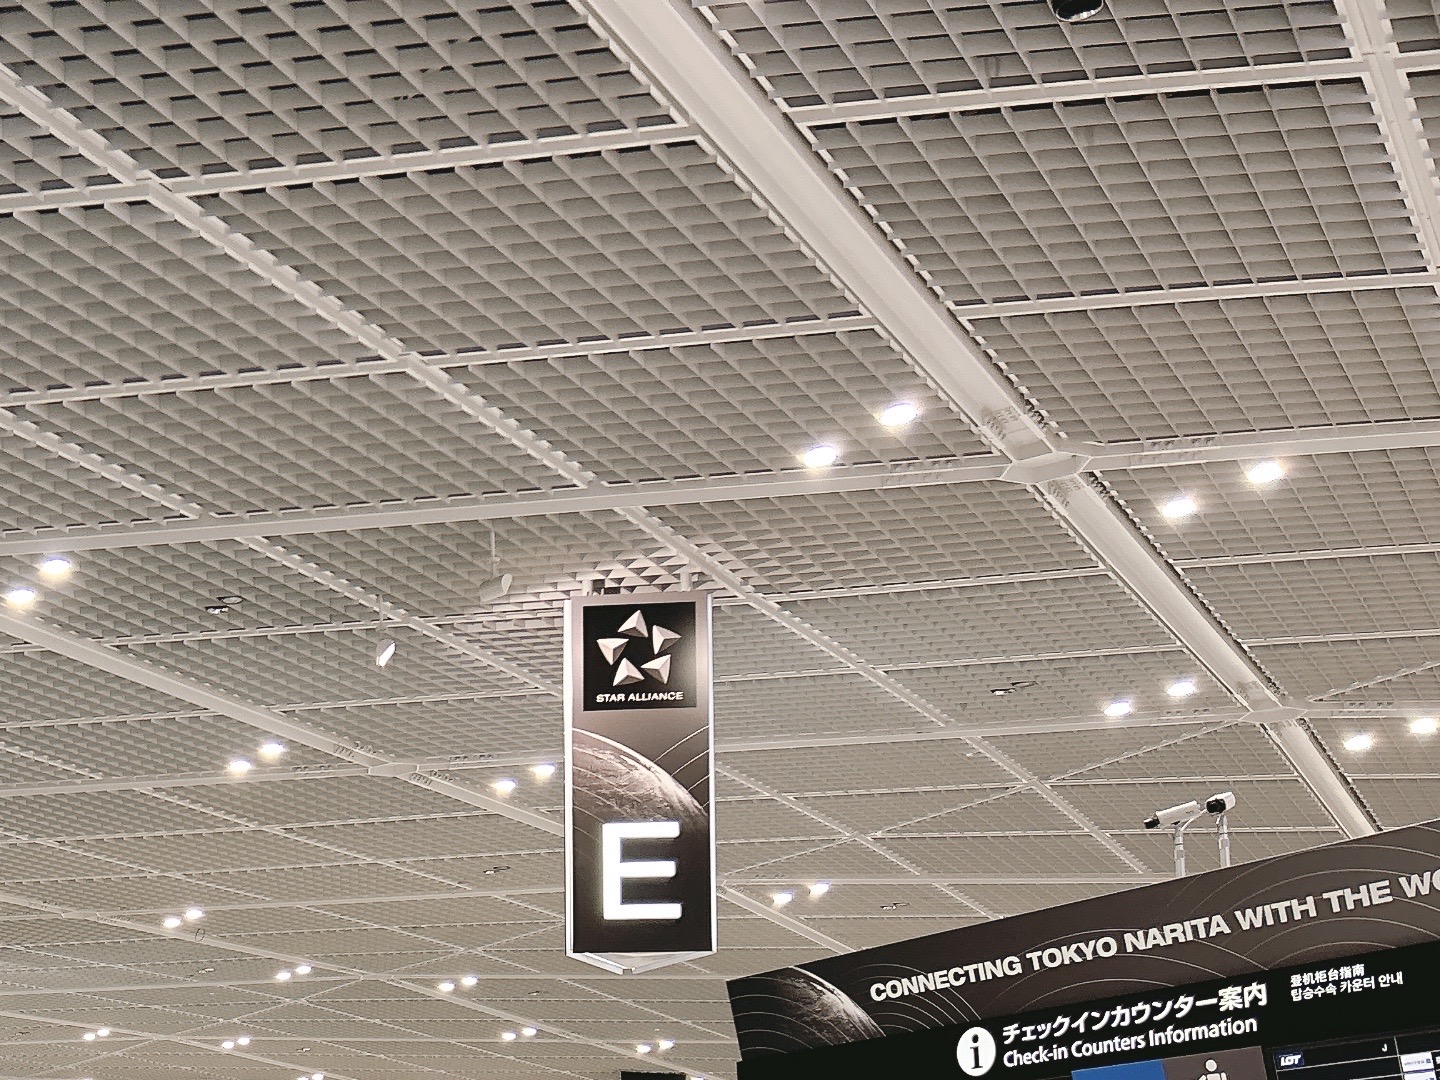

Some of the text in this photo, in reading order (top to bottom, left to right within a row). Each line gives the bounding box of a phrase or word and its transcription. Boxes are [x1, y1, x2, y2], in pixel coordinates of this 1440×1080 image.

[595, 691, 684, 704] STAR ALLIANCE
[602, 821, 682, 920] E
[870, 956, 1023, 1002] CONNECTING
[1026, 936, 1118, 972] TOKYO
[1124, 914, 1232, 953] NARITA
[1234, 896, 1318, 930] WITH
[1322, 880, 1394, 913] THE
[1290, 963, 1365, 988] 登机柜台指南
[1290, 971, 1404, 1002] 탑승수속 카운터 안내
[1002, 981, 1268, 1044] チェックインカウンター案内
[1003, 1017, 1258, 1068] Check-in Counters Information
[1381, 1043, 1388, 1052] J
[1280, 1054, 1302, 1067] LOT
